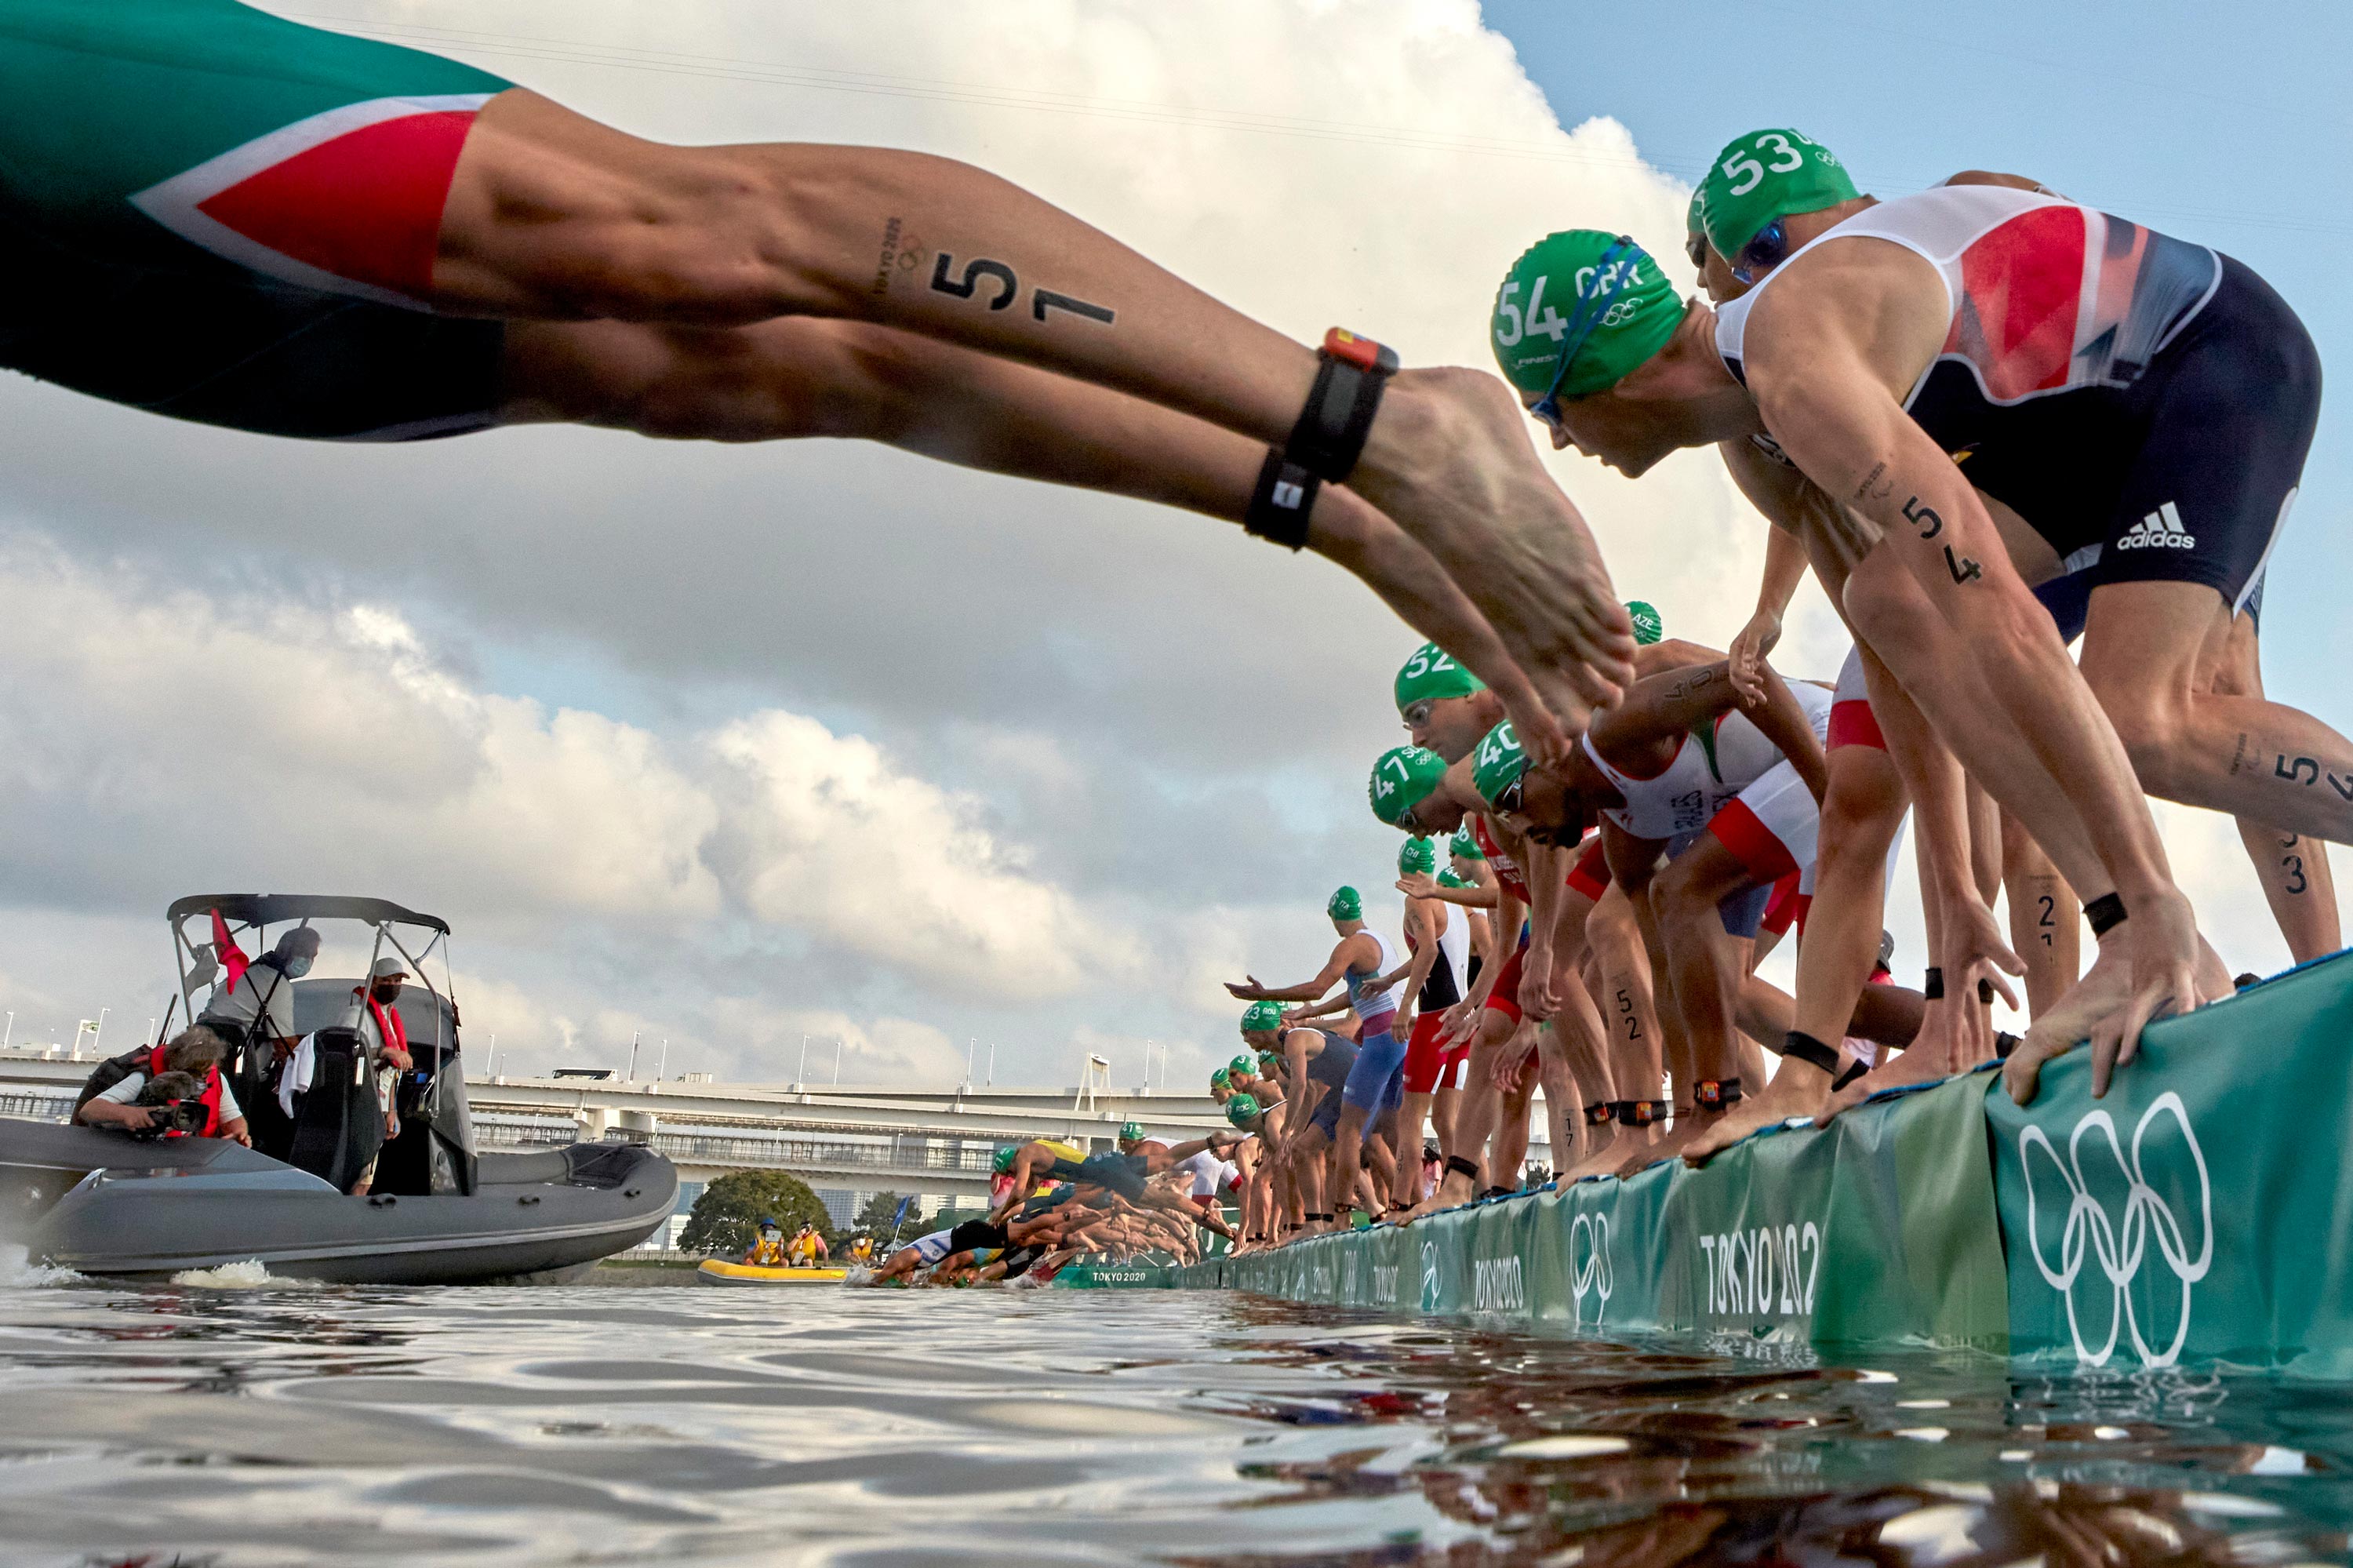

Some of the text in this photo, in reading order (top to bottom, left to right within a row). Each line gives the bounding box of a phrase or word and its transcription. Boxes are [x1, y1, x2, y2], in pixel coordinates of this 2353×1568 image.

[1722, 133, 1803, 196] 53
[931, 253, 1115, 323] 51
[1575, 260, 1644, 300] GBR
[1497, 275, 1569, 346] 54
[2117, 529, 2195, 550] adidas
[1632, 613, 1654, 630] AZE
[1406, 646, 1455, 679] 52
[1375, 755, 1409, 799] 47
[1405, 846, 1420, 858] CHI
[1339, 900, 1350, 910] ITA
[1244, 1006, 1260, 1020] 23
[1617, 989, 1642, 1041] 52
[1093, 1271, 1146, 1282] TOKYO 2020
[1699, 1227, 1773, 1315] TOKYO
